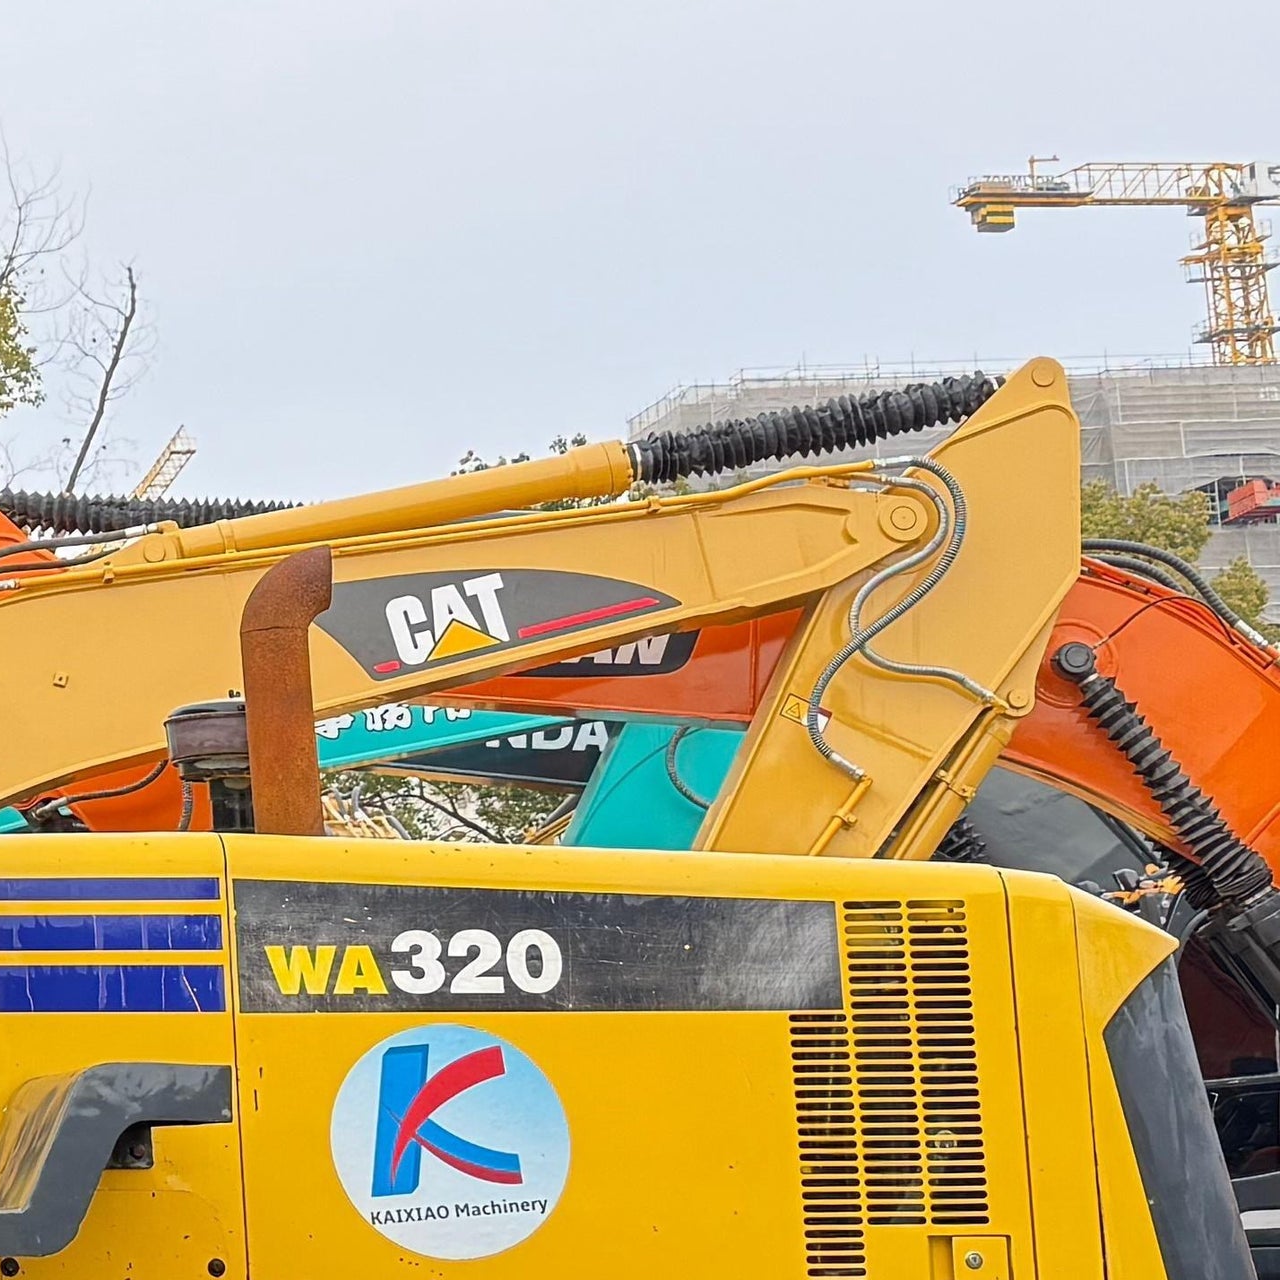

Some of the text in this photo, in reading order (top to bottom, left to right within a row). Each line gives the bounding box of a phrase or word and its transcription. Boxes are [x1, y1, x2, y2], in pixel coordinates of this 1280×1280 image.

[385, 572, 510, 666] CAT
[264, 928, 563, 995] WA320
[370, 1198, 548, 1225] KAIXIAO Machinery
